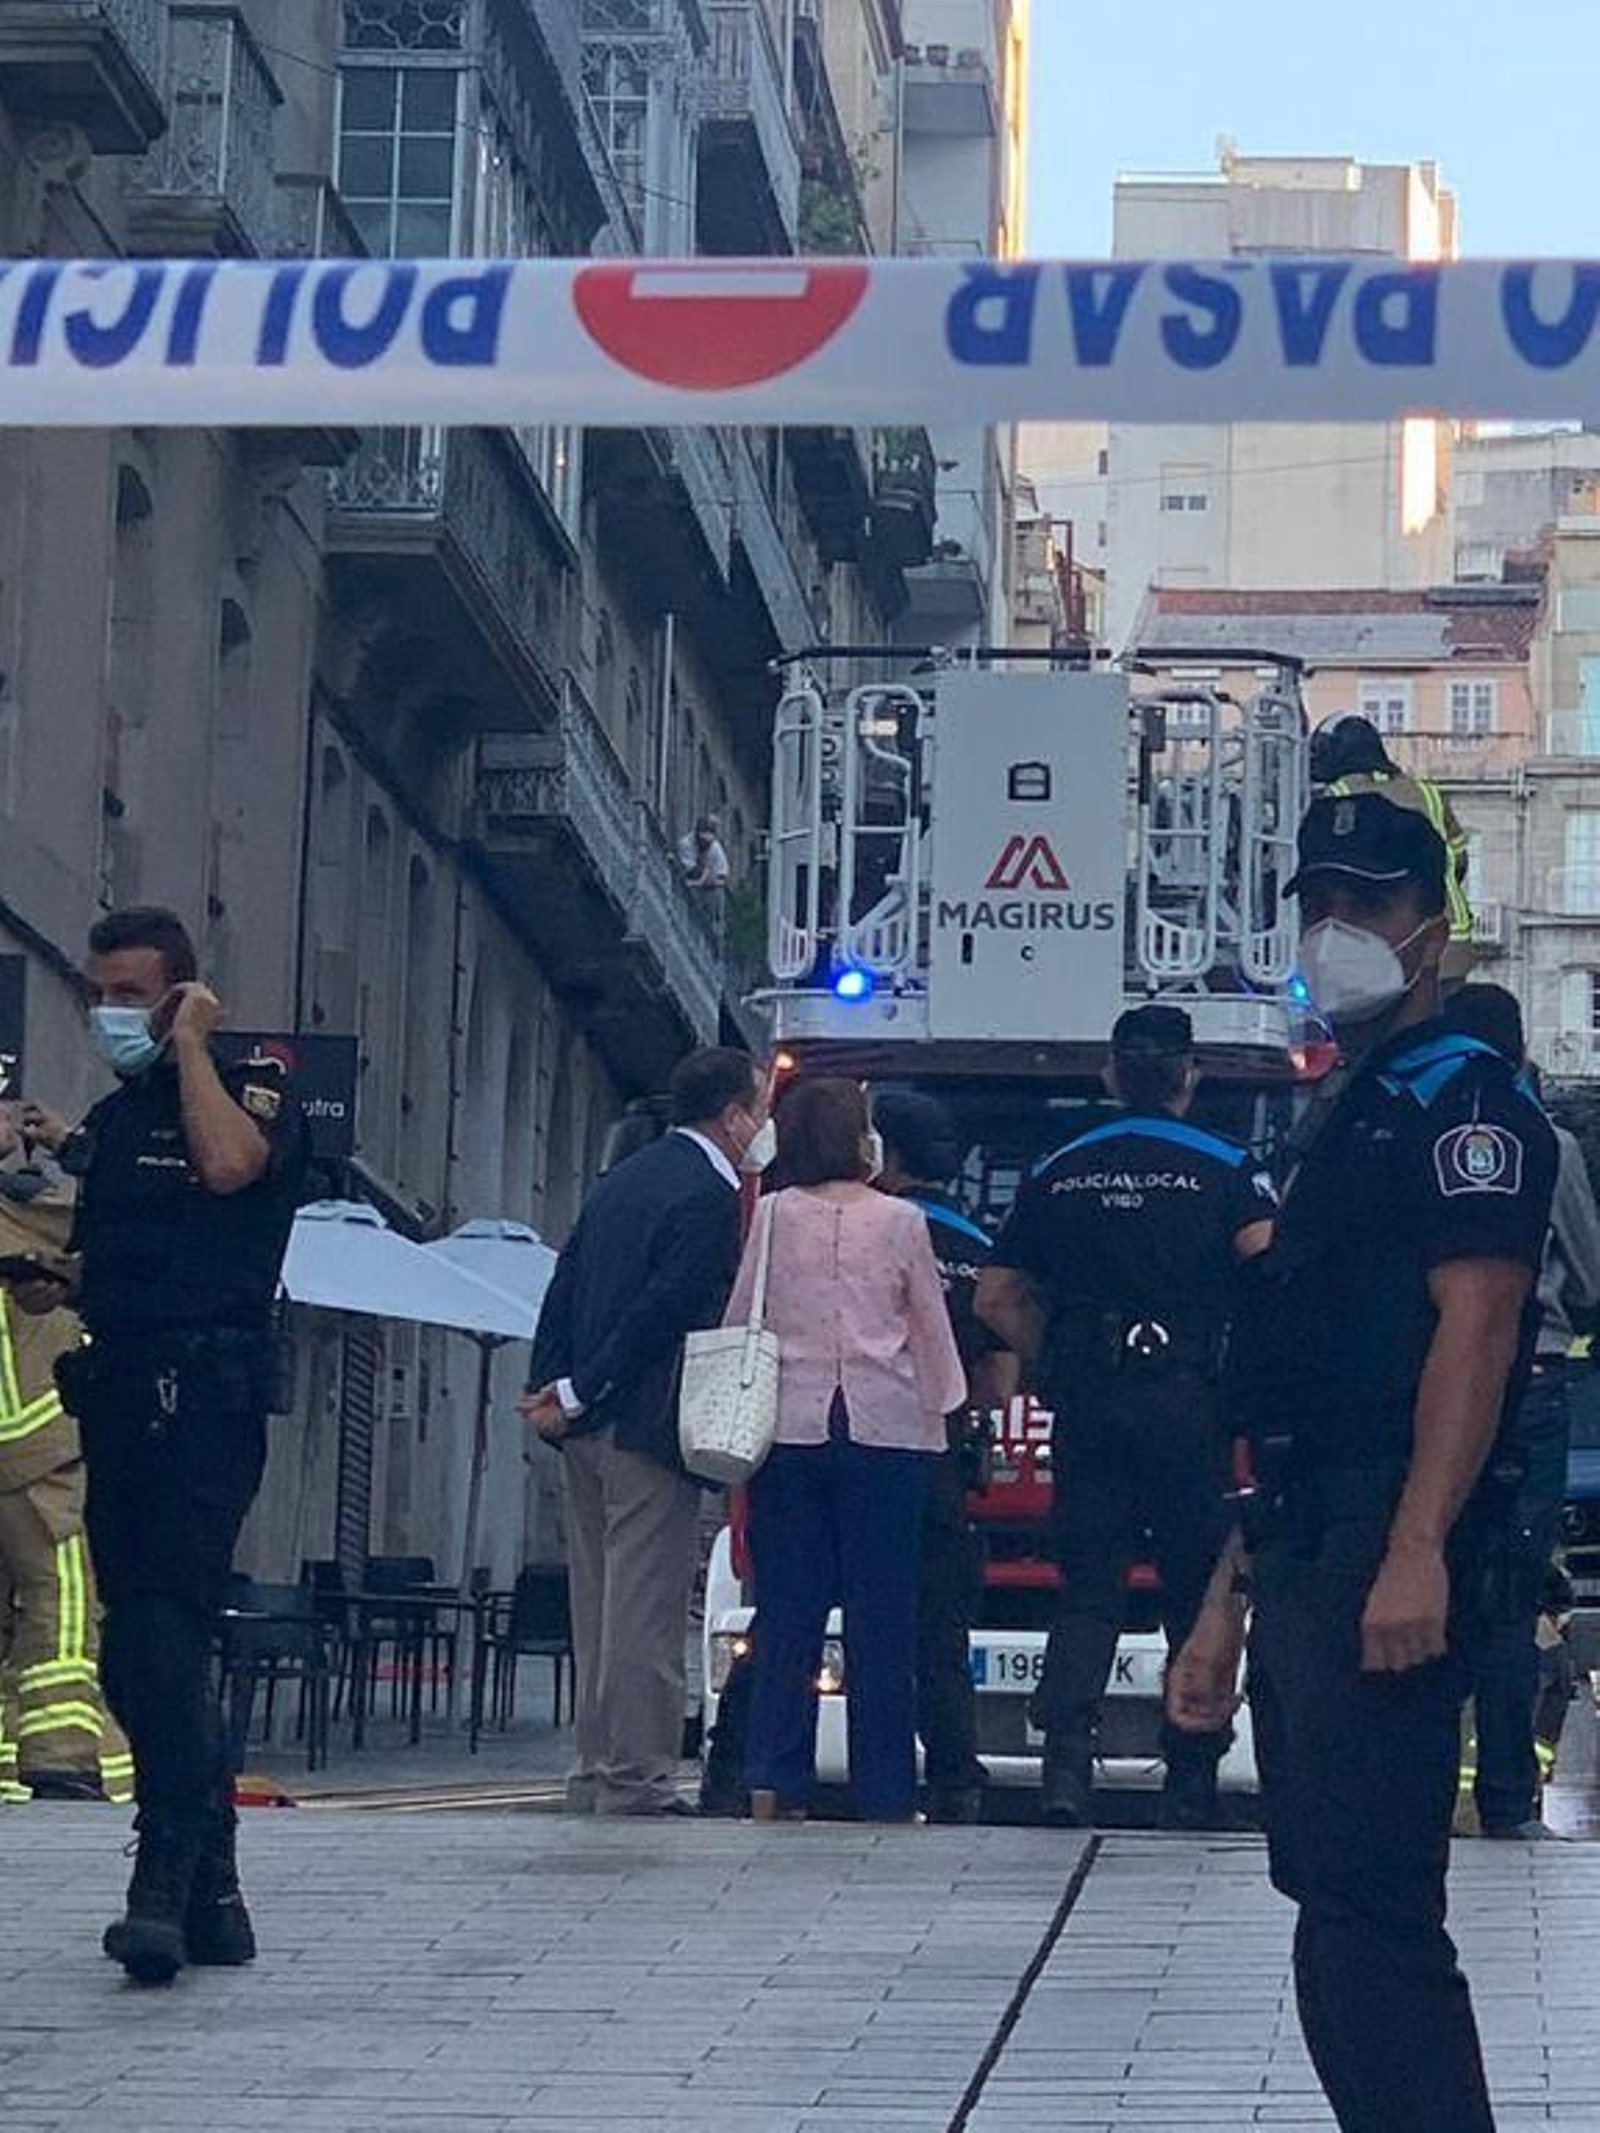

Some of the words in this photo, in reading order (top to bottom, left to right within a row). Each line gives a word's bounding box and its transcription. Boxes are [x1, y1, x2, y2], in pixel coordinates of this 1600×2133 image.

[0, 262, 516, 369] POLICI
[945, 262, 1441, 370] PASAR
[938, 902, 1115, 931] MAGIRUS
[1134, 1172, 1201, 1191] LOCAL
[997, 1653, 1046, 1682] 198
